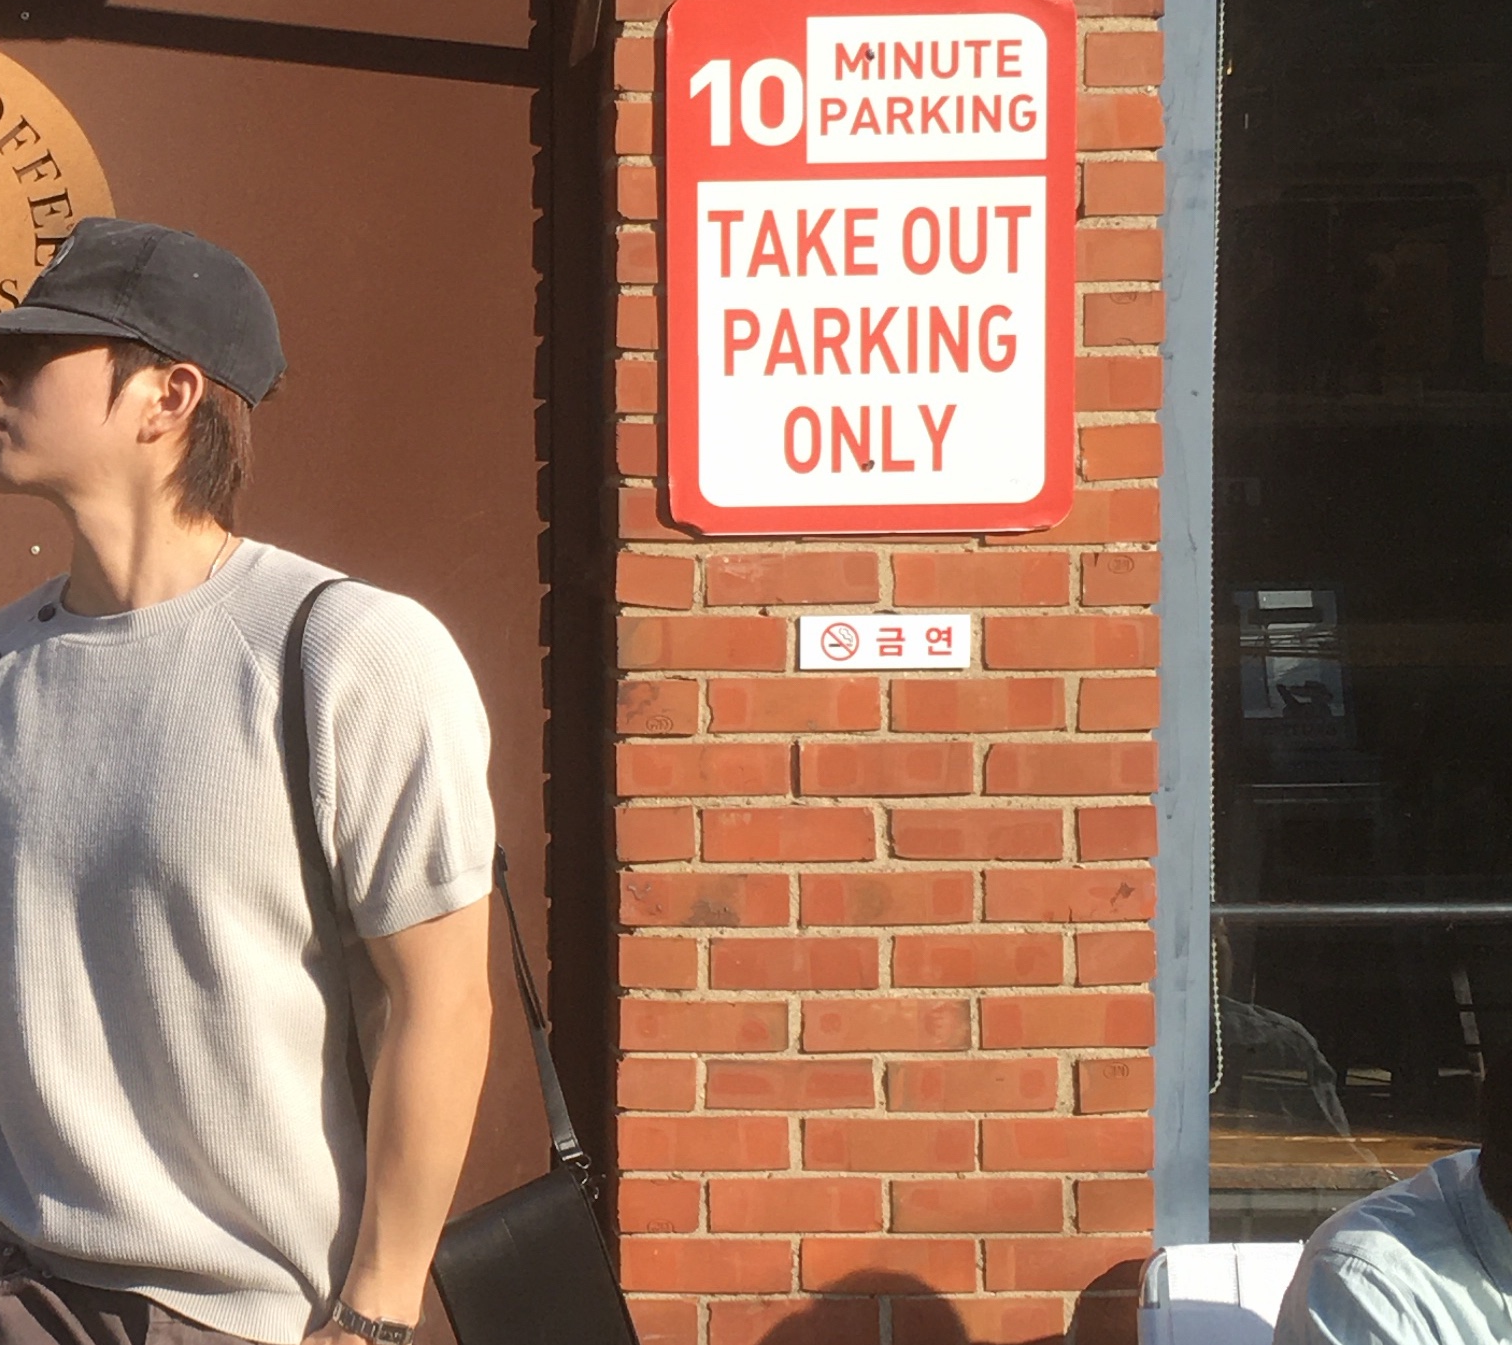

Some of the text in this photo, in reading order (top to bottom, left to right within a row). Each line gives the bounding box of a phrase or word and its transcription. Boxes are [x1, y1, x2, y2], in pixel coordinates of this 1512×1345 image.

[834, 39, 1023, 81] MINUTE
[689, 58, 804, 147] 10
[819, 94, 1038, 136] PARKING
[707, 205, 1031, 278] TAKE OUT
[723, 304, 1017, 377] PARKING
[783, 404, 958, 474] ONLY
